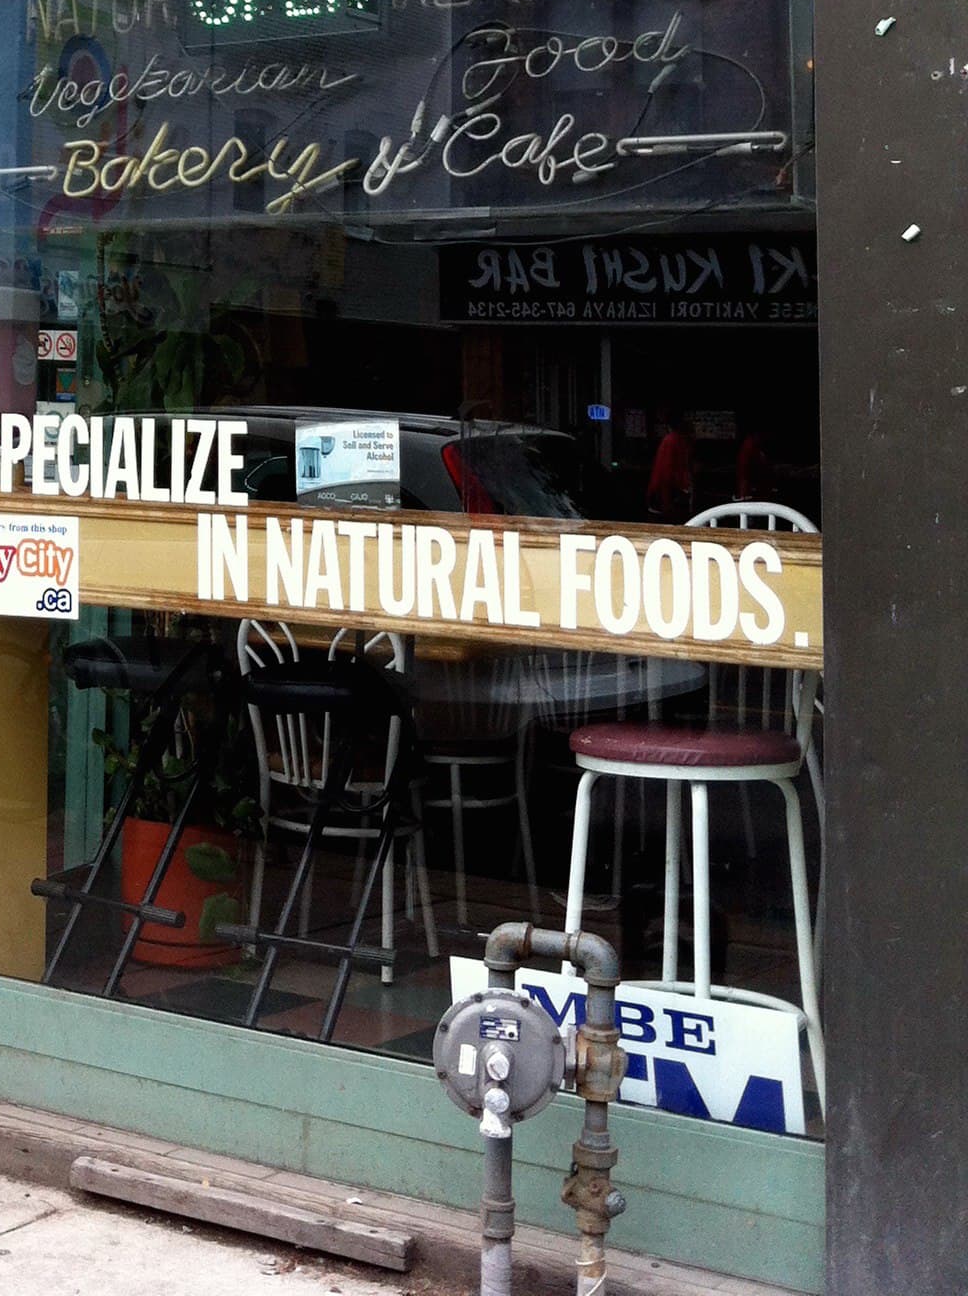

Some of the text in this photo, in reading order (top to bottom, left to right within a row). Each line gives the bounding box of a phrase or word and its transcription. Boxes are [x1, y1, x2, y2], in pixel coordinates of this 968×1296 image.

[29, 10, 689, 128] Vegetarian Food
[62, 120, 360, 216] Bakery
[443, 112, 616, 186] Cafe
[353, 430, 394, 439] Licensed to
[358, 441, 371, 450] and
[373, 441, 394, 451] Serve
[366, 452, 394, 462] Alcohol
[8, 522, 29, 532] from
[31, 523, 46, 533] this
[48, 524, 67, 535] shop
[197, 513, 809, 648] IN NATURAL FOODS.
[36, 588, 72, 613] .ca
